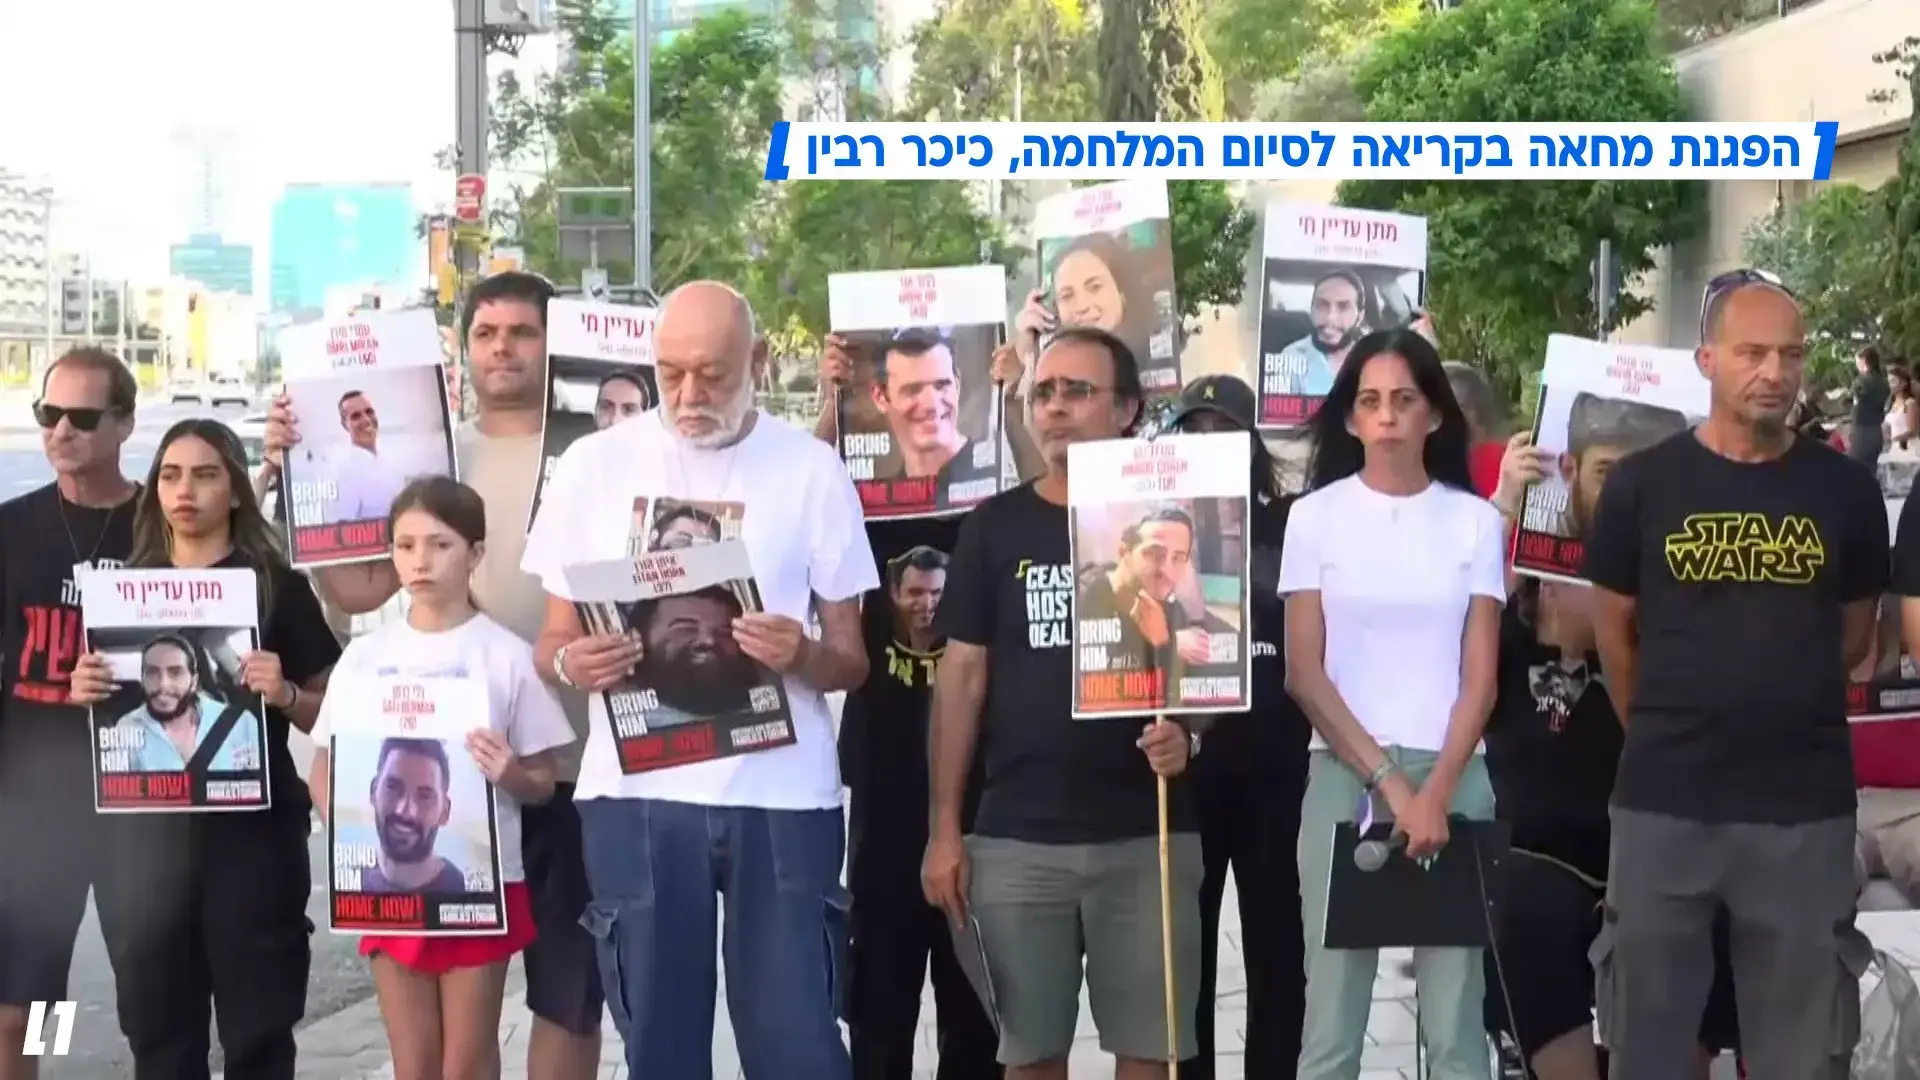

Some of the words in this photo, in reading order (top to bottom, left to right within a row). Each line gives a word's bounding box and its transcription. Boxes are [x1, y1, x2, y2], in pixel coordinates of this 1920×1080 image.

[1298, 215, 1316, 236] חי
[1321, 217, 1361, 240] עדיין
[1366, 219, 1398, 243] מתן
[581, 312, 598, 332] חי
[604, 315, 645, 339] עדיין
[1665, 513, 1823, 553] STAM
[1665, 544, 1824, 584] WARS
[1026, 565, 1073, 590] CEAS
[115, 580, 135, 601] חי
[142, 580, 183, 605] עדיין
[189, 581, 222, 603] מתן
[1026, 590, 1073, 622] HOS
[1029, 620, 1072, 648] DEAL
[610, 687, 660, 716] BRING
[614, 712, 649, 739] HIM
